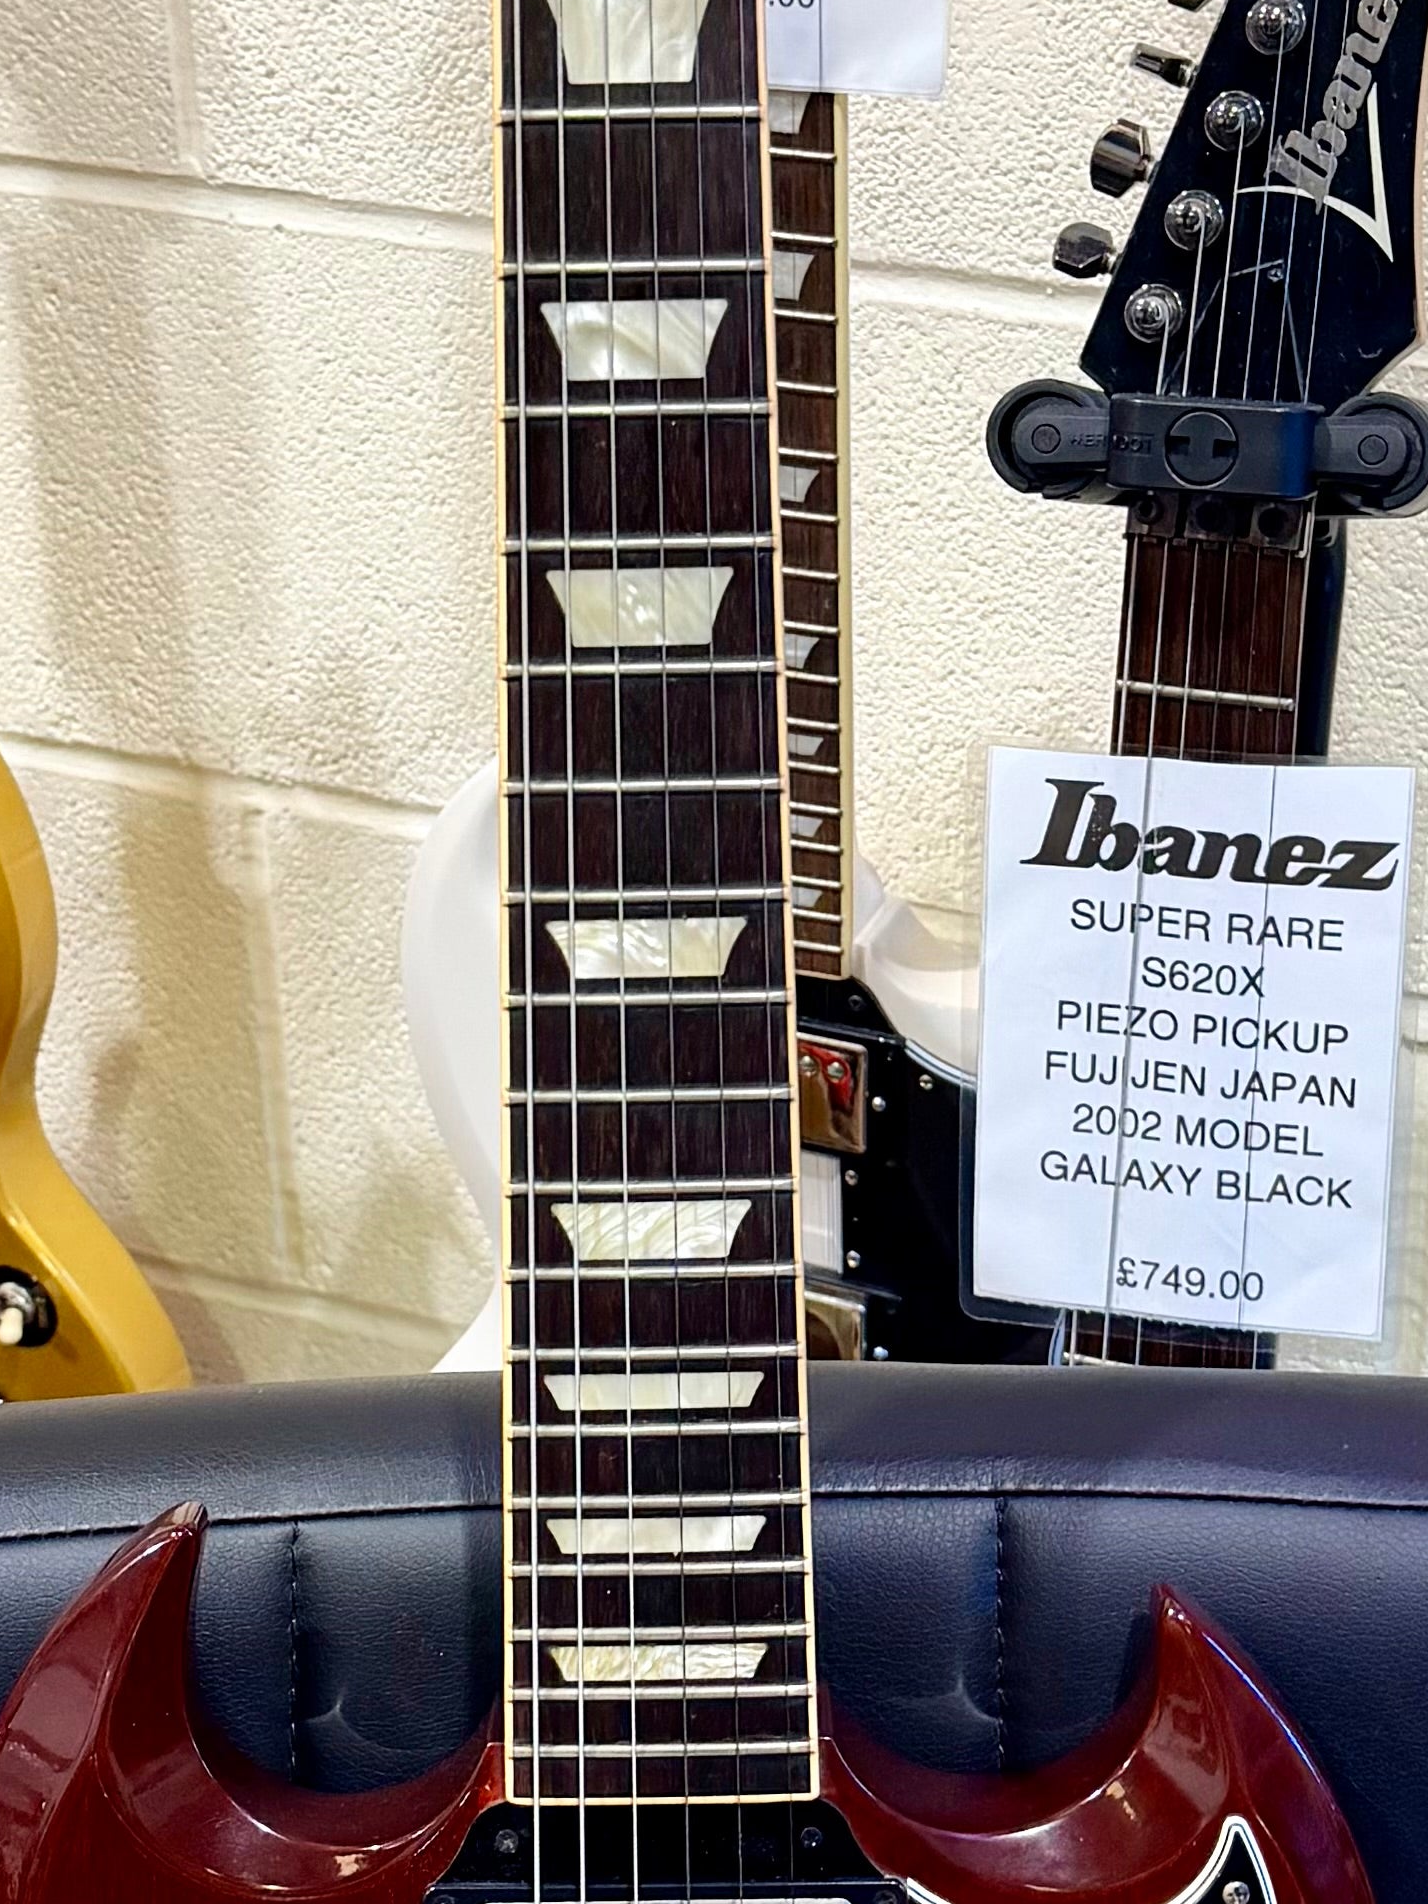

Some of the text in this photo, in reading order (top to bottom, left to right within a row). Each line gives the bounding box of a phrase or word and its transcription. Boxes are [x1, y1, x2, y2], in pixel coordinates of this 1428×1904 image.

[1019, 777, 1401, 892] Ibanez
[1070, 898, 1346, 952] SUPER RARE
[1141, 956, 1266, 998] S620X
[1057, 1000, 1350, 1056] PIEZO PICKUP
[1220, 1070, 1357, 1109] JAPAN
[1072, 1103, 1325, 1157] 2002 MODEL
[1040, 1151, 1353, 1209] GALAXY BLACK
[1115, 1257, 1265, 1303] £749.00
